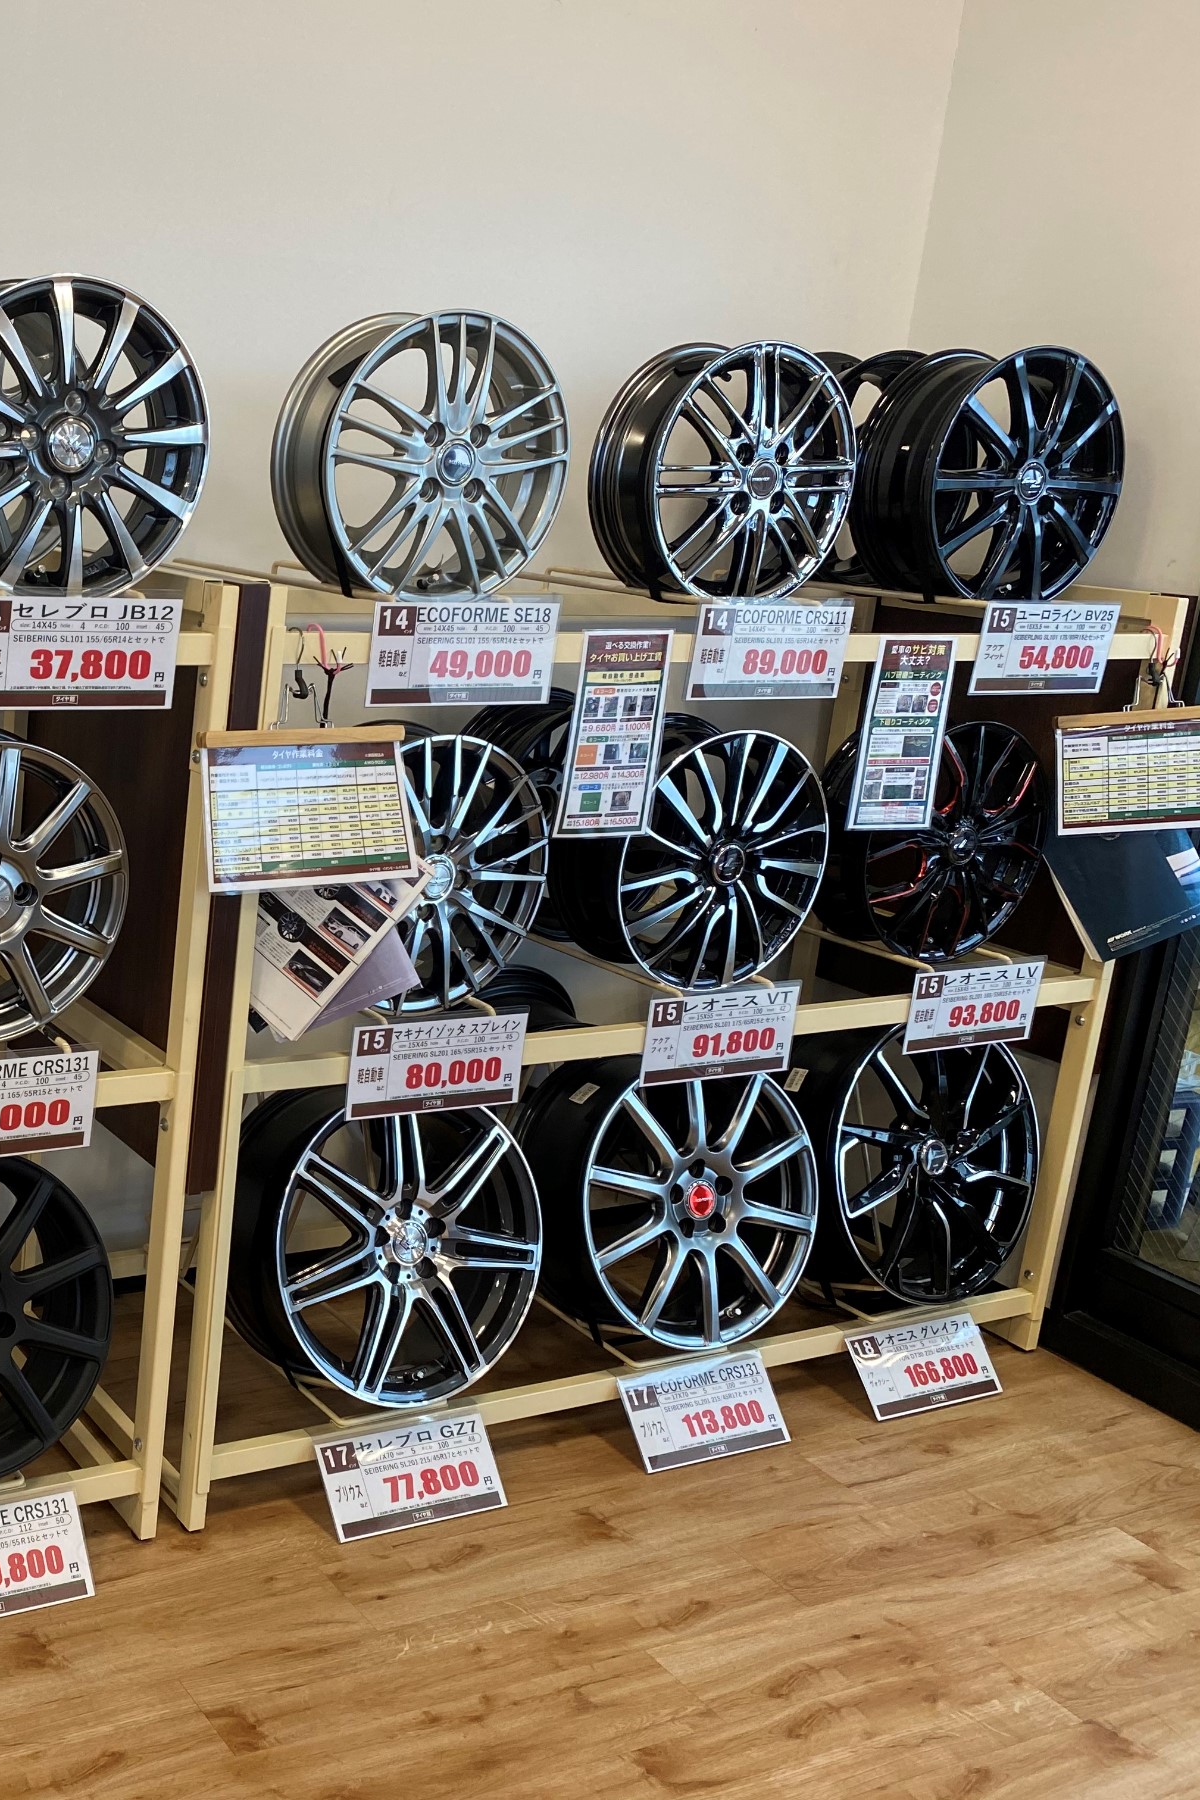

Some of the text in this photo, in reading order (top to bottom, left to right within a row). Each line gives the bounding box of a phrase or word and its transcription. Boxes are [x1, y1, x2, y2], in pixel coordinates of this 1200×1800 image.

[13, 603, 173, 620] セレブロ JB12
[417, 607, 551, 622] ECOFORME SE18
[735, 609, 847, 624] ECOFORME CRS111
[1017, 609, 1114, 621] ユーロライン BV25
[29, 649, 151, 682] 37,800
[429, 650, 532, 680] 49,000
[743, 649, 828, 677] 89,000
[1019, 645, 1094, 670] 54,800
[944, 966, 1039, 986] レオニス LV
[684, 991, 793, 1012] レオニス VT
[949, 999, 1020, 1028] 93,800
[393, 1020, 521, 1040] マキナイゾッタ スプレイン
[651, 1044, 674, 1053] フィット
[692, 1027, 776, 1057] 91,800
[33, 1057, 89, 1076] CRS131
[393, 1052, 428, 1061] SEIBERING
[36, 1077, 49, 1085] 100
[405, 1057, 502, 1089] 80,000
[877, 1331, 917, 1347] レオニス
[654, 1362, 760, 1395] ECOFORME CRS131
[904, 1353, 978, 1387] 166,800
[440, 1420, 476, 1438] GZ7
[682, 1400, 765, 1438] 113,800
[364, 1463, 399, 1475] SEIBERING
[383, 1461, 479, 1504] 77,800
[335, 1485, 363, 1503] プリウス
[14, 1498, 69, 1522] CRS131
